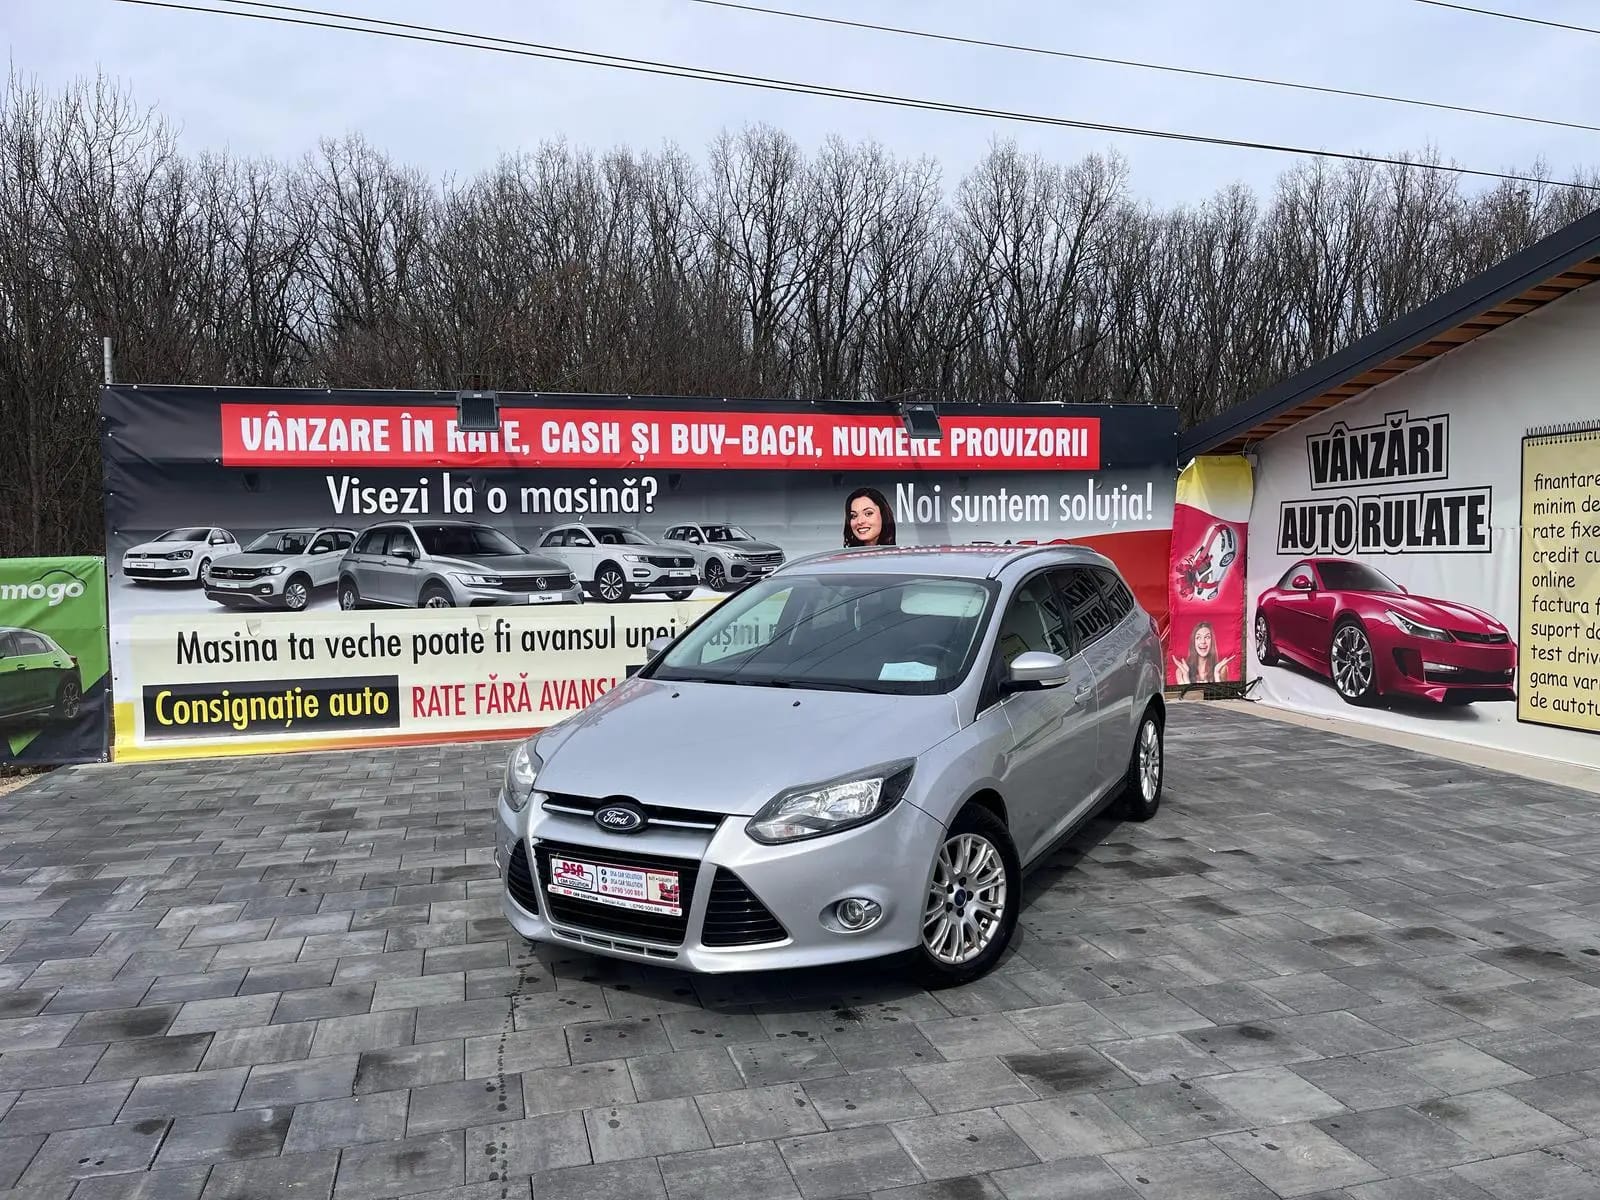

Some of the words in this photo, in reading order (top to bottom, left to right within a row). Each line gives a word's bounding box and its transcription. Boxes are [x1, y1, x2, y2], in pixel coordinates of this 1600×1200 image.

[241, 411, 390, 452] VÂNZARE
[401, 412, 434, 452] ÎN
[541, 421, 620, 454] CASH
[631, 423, 659, 462] ȘI
[671, 424, 822, 458] BUY-BACK,
[832, 427, 941, 457] NUMERE
[950, 428, 1088, 457] PROVIZORII
[1311, 418, 1443, 484] VÂNZĂRI
[326, 476, 429, 514] Visezi
[443, 472, 473, 513] la
[487, 487, 507, 514] o
[520, 476, 658, 522] mașină?
[896, 483, 941, 522] Noi
[951, 488, 1049, 522] suntem
[1060, 479, 1152, 528] soluția!
[1533, 496, 1576, 515] minim
[1281, 503, 1353, 549] AUTO
[1362, 494, 1486, 547] RULATE
[1532, 523, 1566, 539] rate
[1532, 546, 1579, 563] credit
[1531, 570, 1576, 588] online
[1, 582, 84, 607] mogo
[1531, 594, 1589, 614] factura
[177, 631, 277, 664] Masina
[287, 633, 315, 660] ta
[324, 623, 401, 658] veche
[412, 628, 485, 664] poate
[495, 619, 511, 652] fi
[521, 616, 615, 652] avansul
[1530, 622, 1580, 641] suport
[1530, 644, 1563, 662] test
[1568, 645, 1600, 665] driv
[1530, 672, 1567, 688] gama
[1573, 676, 1600, 690] var
[411, 684, 467, 718] RATE
[474, 672, 532, 714] FĂRĂ
[1530, 691, 1548, 708] de
[156, 687, 318, 731] Consignație
[329, 687, 389, 716] auto
[603, 809, 628, 825] Ford
[562, 861, 584, 877] DSA
